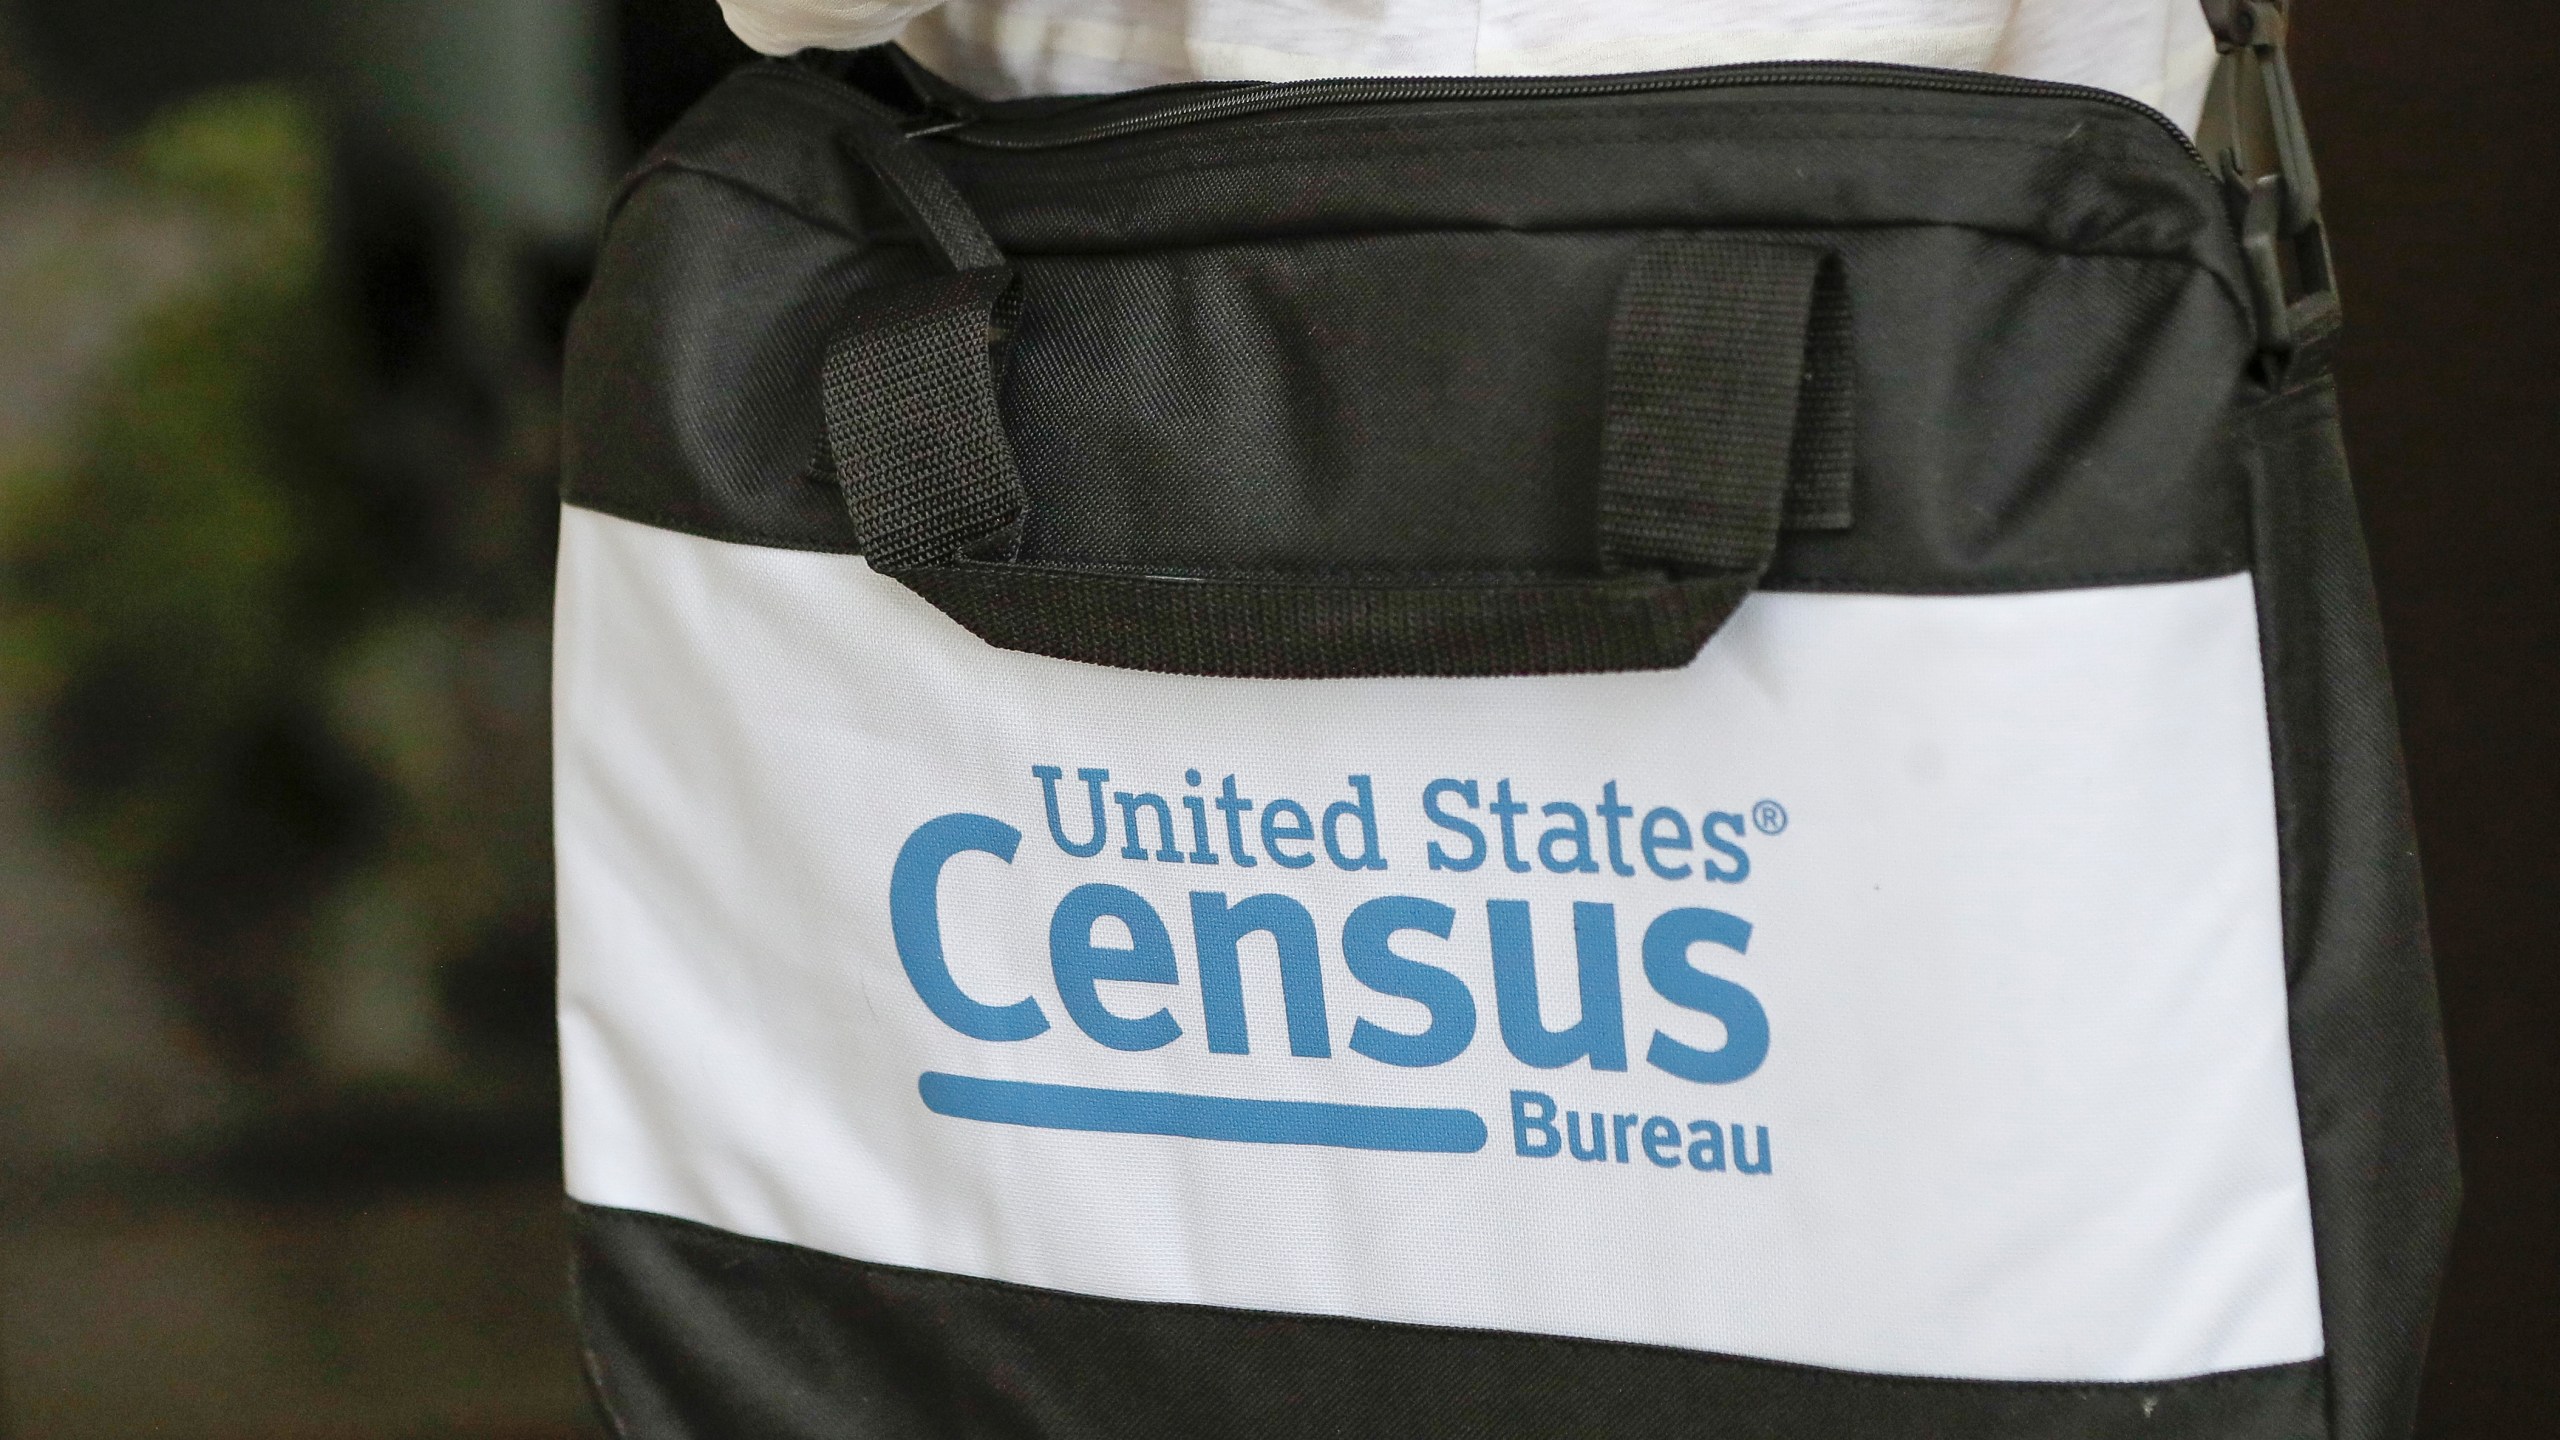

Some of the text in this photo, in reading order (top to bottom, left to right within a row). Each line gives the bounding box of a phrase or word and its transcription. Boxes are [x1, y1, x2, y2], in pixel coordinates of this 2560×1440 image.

[1031, 764, 1389, 872] United
[889, 812, 1771, 1085] Census
[1510, 1089, 1773, 1175] Bureau
